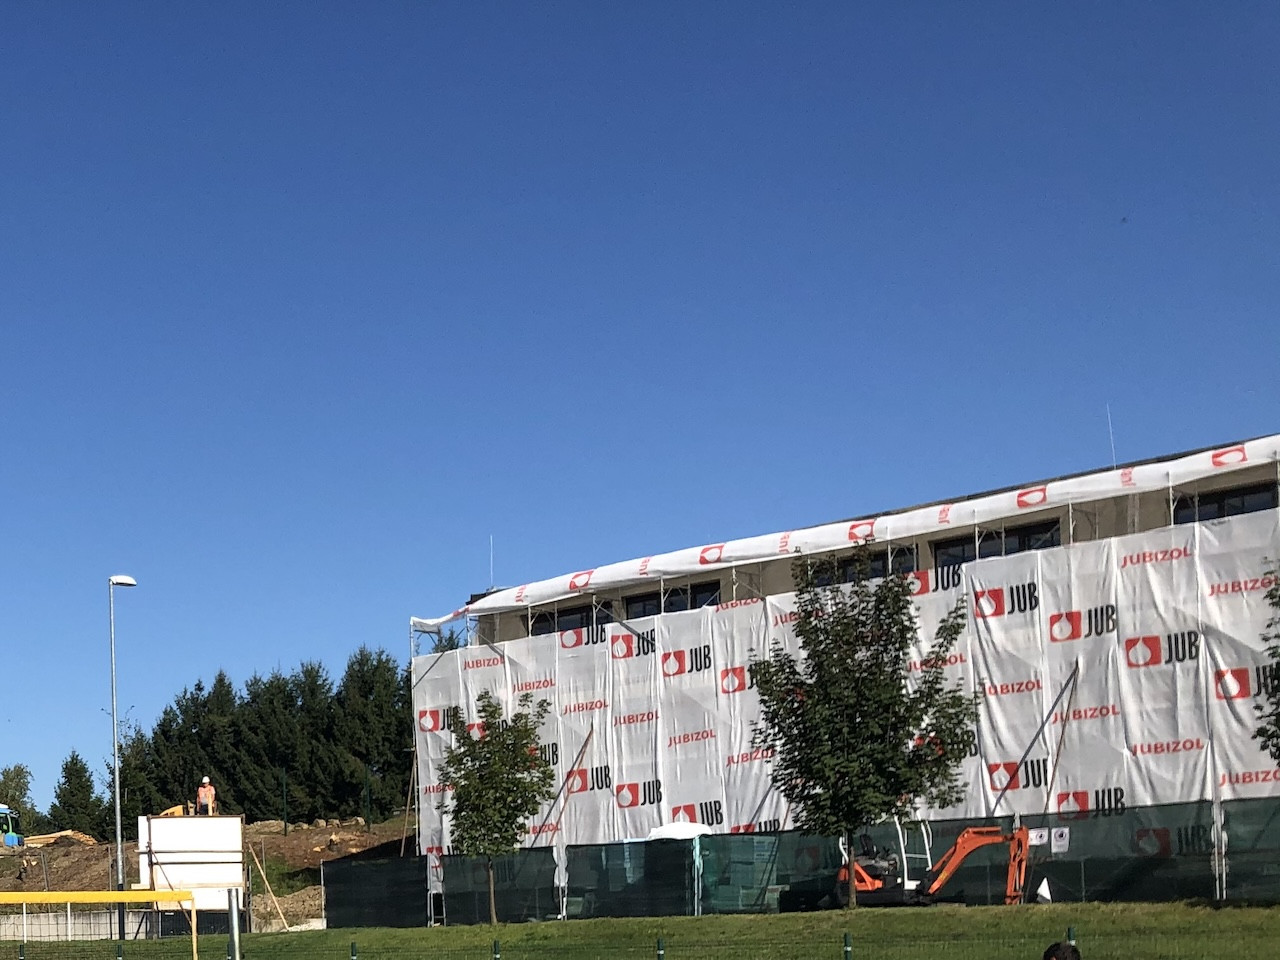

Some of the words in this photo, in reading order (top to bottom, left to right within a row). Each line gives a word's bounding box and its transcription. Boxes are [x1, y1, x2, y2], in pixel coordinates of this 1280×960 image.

[1121, 546, 1193, 568] JUBIZOL
[932, 564, 962, 593] JUB
[1008, 582, 1039, 614] JUB
[584, 624, 606, 646] JUB
[1084, 605, 1117, 638] JUB
[635, 628, 656, 657] JUB
[1164, 630, 1200, 665] JUB
[463, 656, 506, 670] JUBIZOL
[687, 644, 712, 674] JUB
[512, 677, 557, 694] JUBIZOL
[563, 698, 610, 715] JUBIZOL
[614, 709, 661, 727] JUBIZOL
[1052, 704, 1121, 726] JUBIZOL
[667, 728, 717, 748] JUBIZOL
[1131, 738, 1205, 757] JUBIZOL
[589, 764, 612, 791] JUB
[640, 779, 663, 806] JUB
[1091, 786, 1127, 818] JUB
[700, 799, 724, 827] JUB
